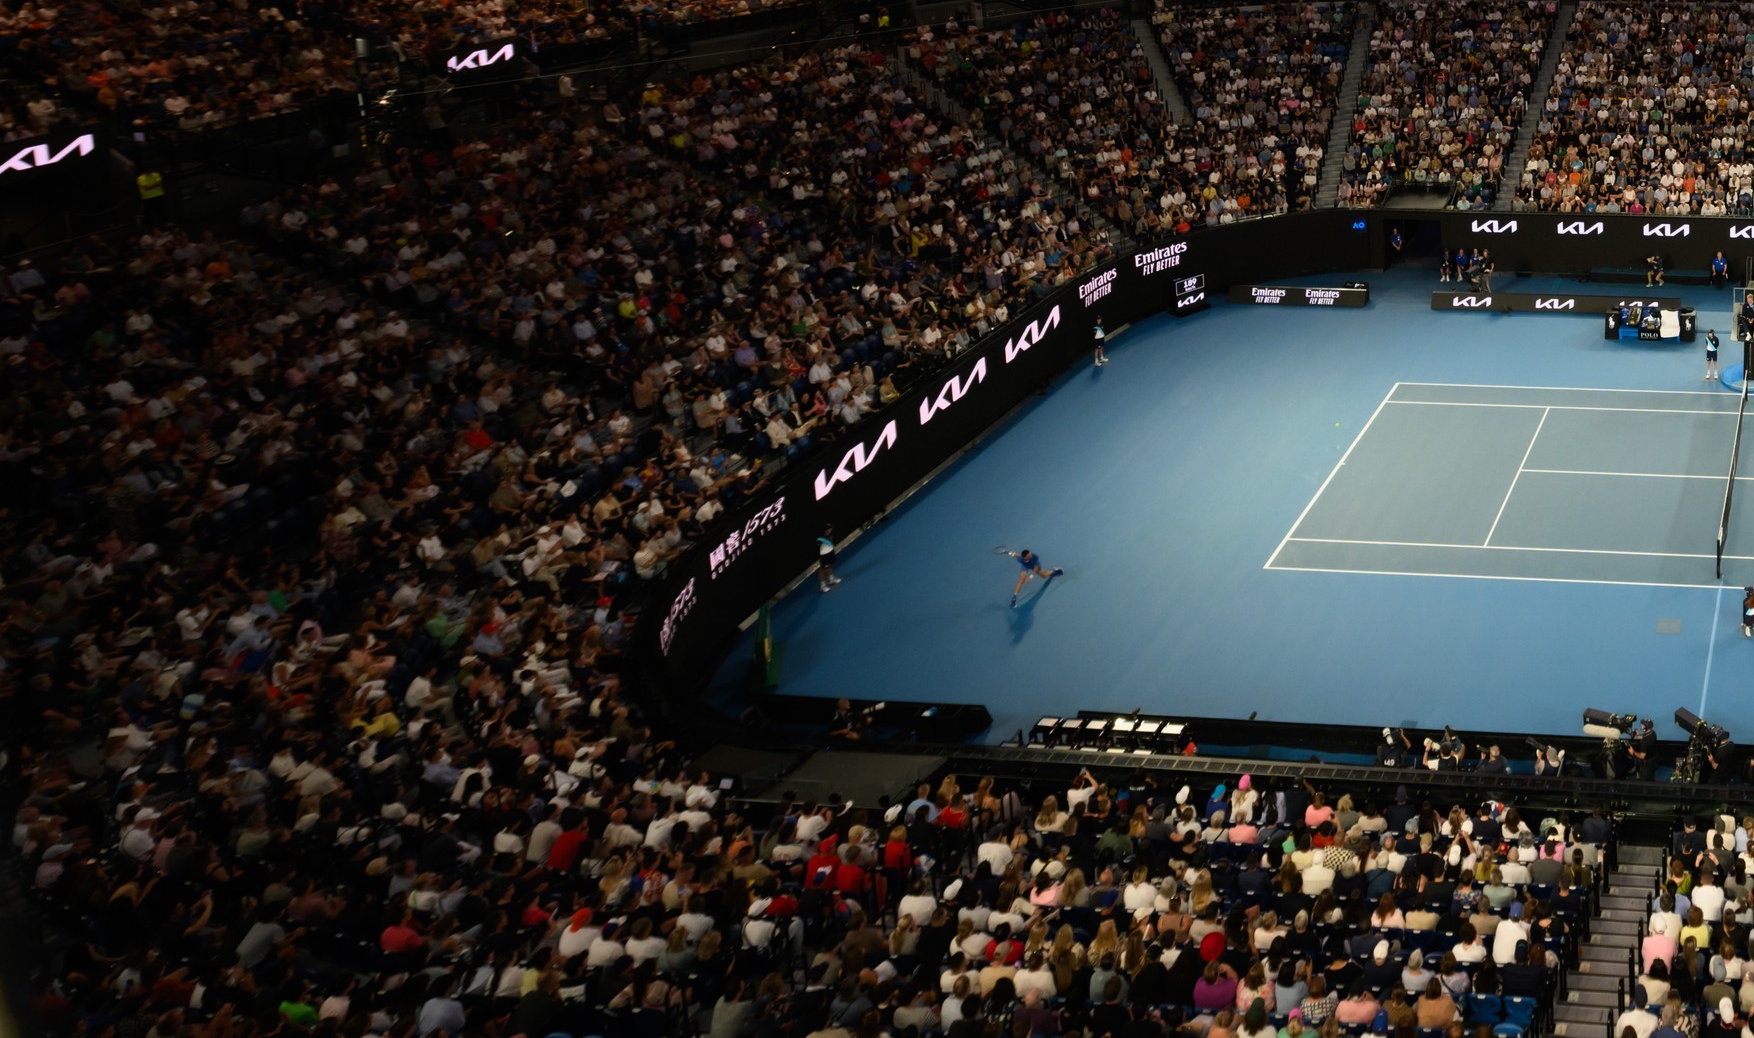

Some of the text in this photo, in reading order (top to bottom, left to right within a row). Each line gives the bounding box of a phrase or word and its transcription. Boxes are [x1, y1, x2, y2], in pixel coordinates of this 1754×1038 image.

[447, 43, 514, 72] KIA
[1472, 219, 1518, 233] KIA
[1557, 221, 1604, 235] KIA
[1643, 223, 1690, 237] KIA
[1134, 242, 1188, 268] Emirates
[1143, 255, 1180, 276] FLY BETTER
[1079, 268, 1117, 299] Emirates
[1251, 287, 1286, 297] Emirates
[1085, 282, 1112, 308] FLY BETTER
[1178, 292, 1204, 308] KIA
[1305, 289, 1340, 298] Emirates
[1453, 296, 1492, 308] KIA
[1535, 298, 1575, 310] KIA
[1004, 305, 1060, 364] KIA
[919, 356, 987, 425] KIA
[814, 419, 897, 501] KIA
